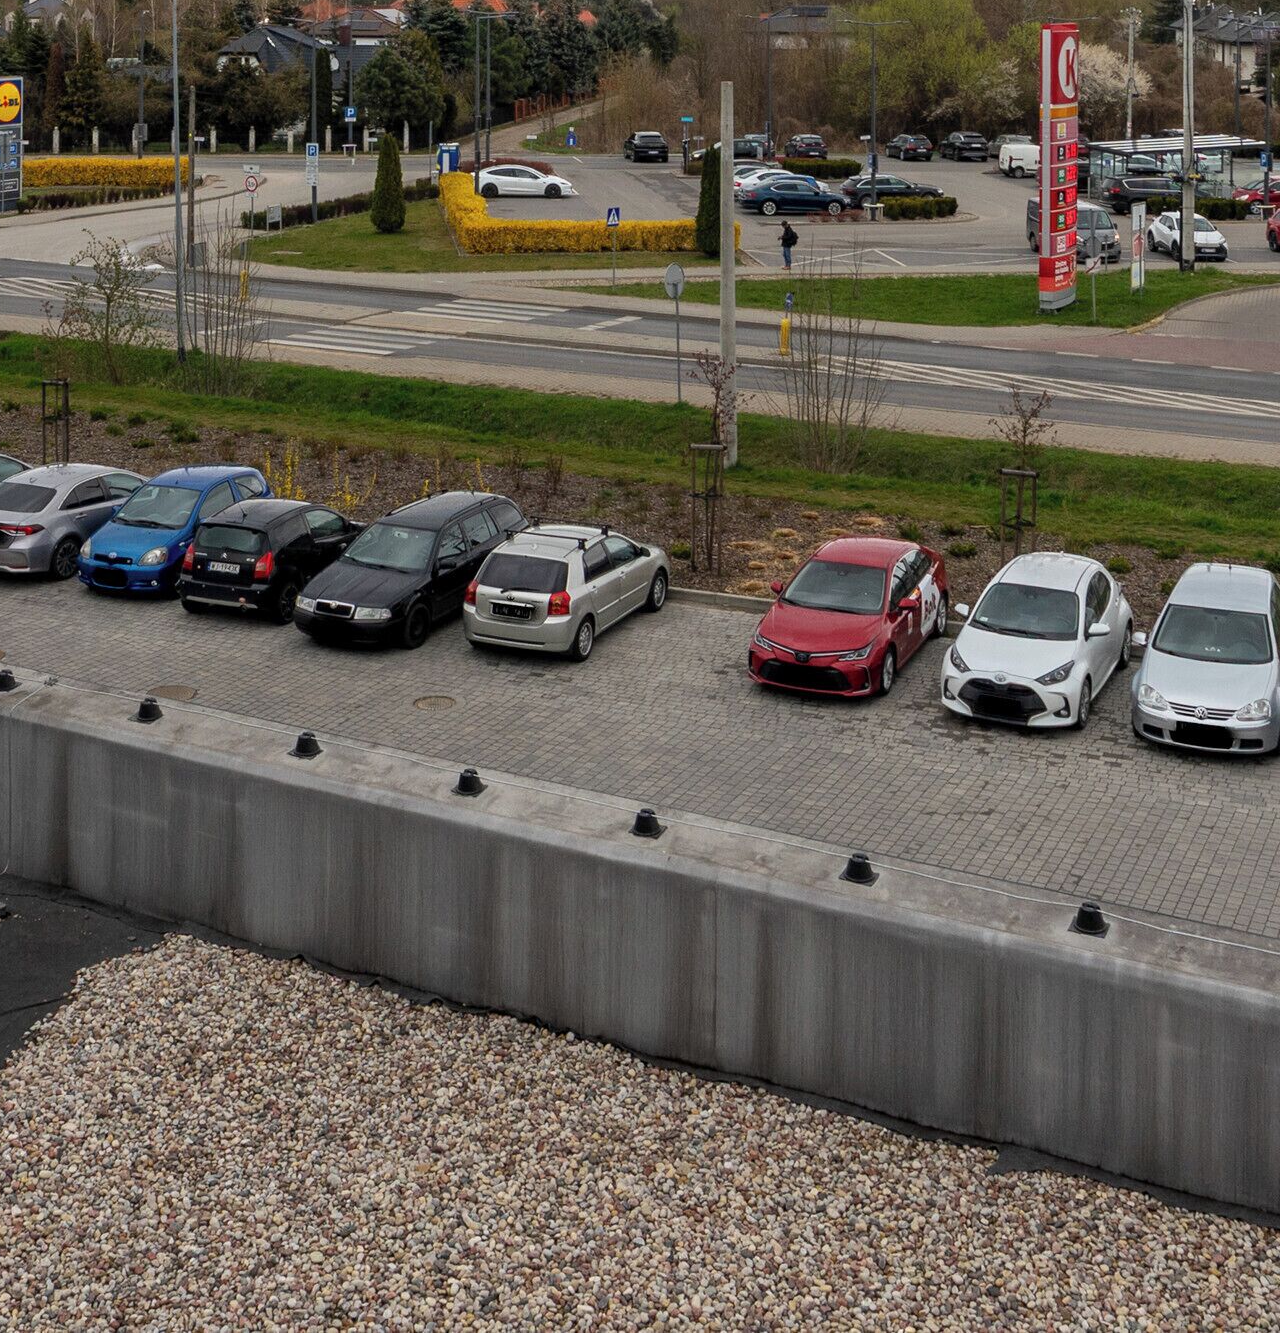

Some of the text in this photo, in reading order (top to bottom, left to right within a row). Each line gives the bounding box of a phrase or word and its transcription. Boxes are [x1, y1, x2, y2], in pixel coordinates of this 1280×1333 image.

[1066, 49, 1078, 87] K
[347, 108, 355, 119] P
[309, 146, 316, 156] P
